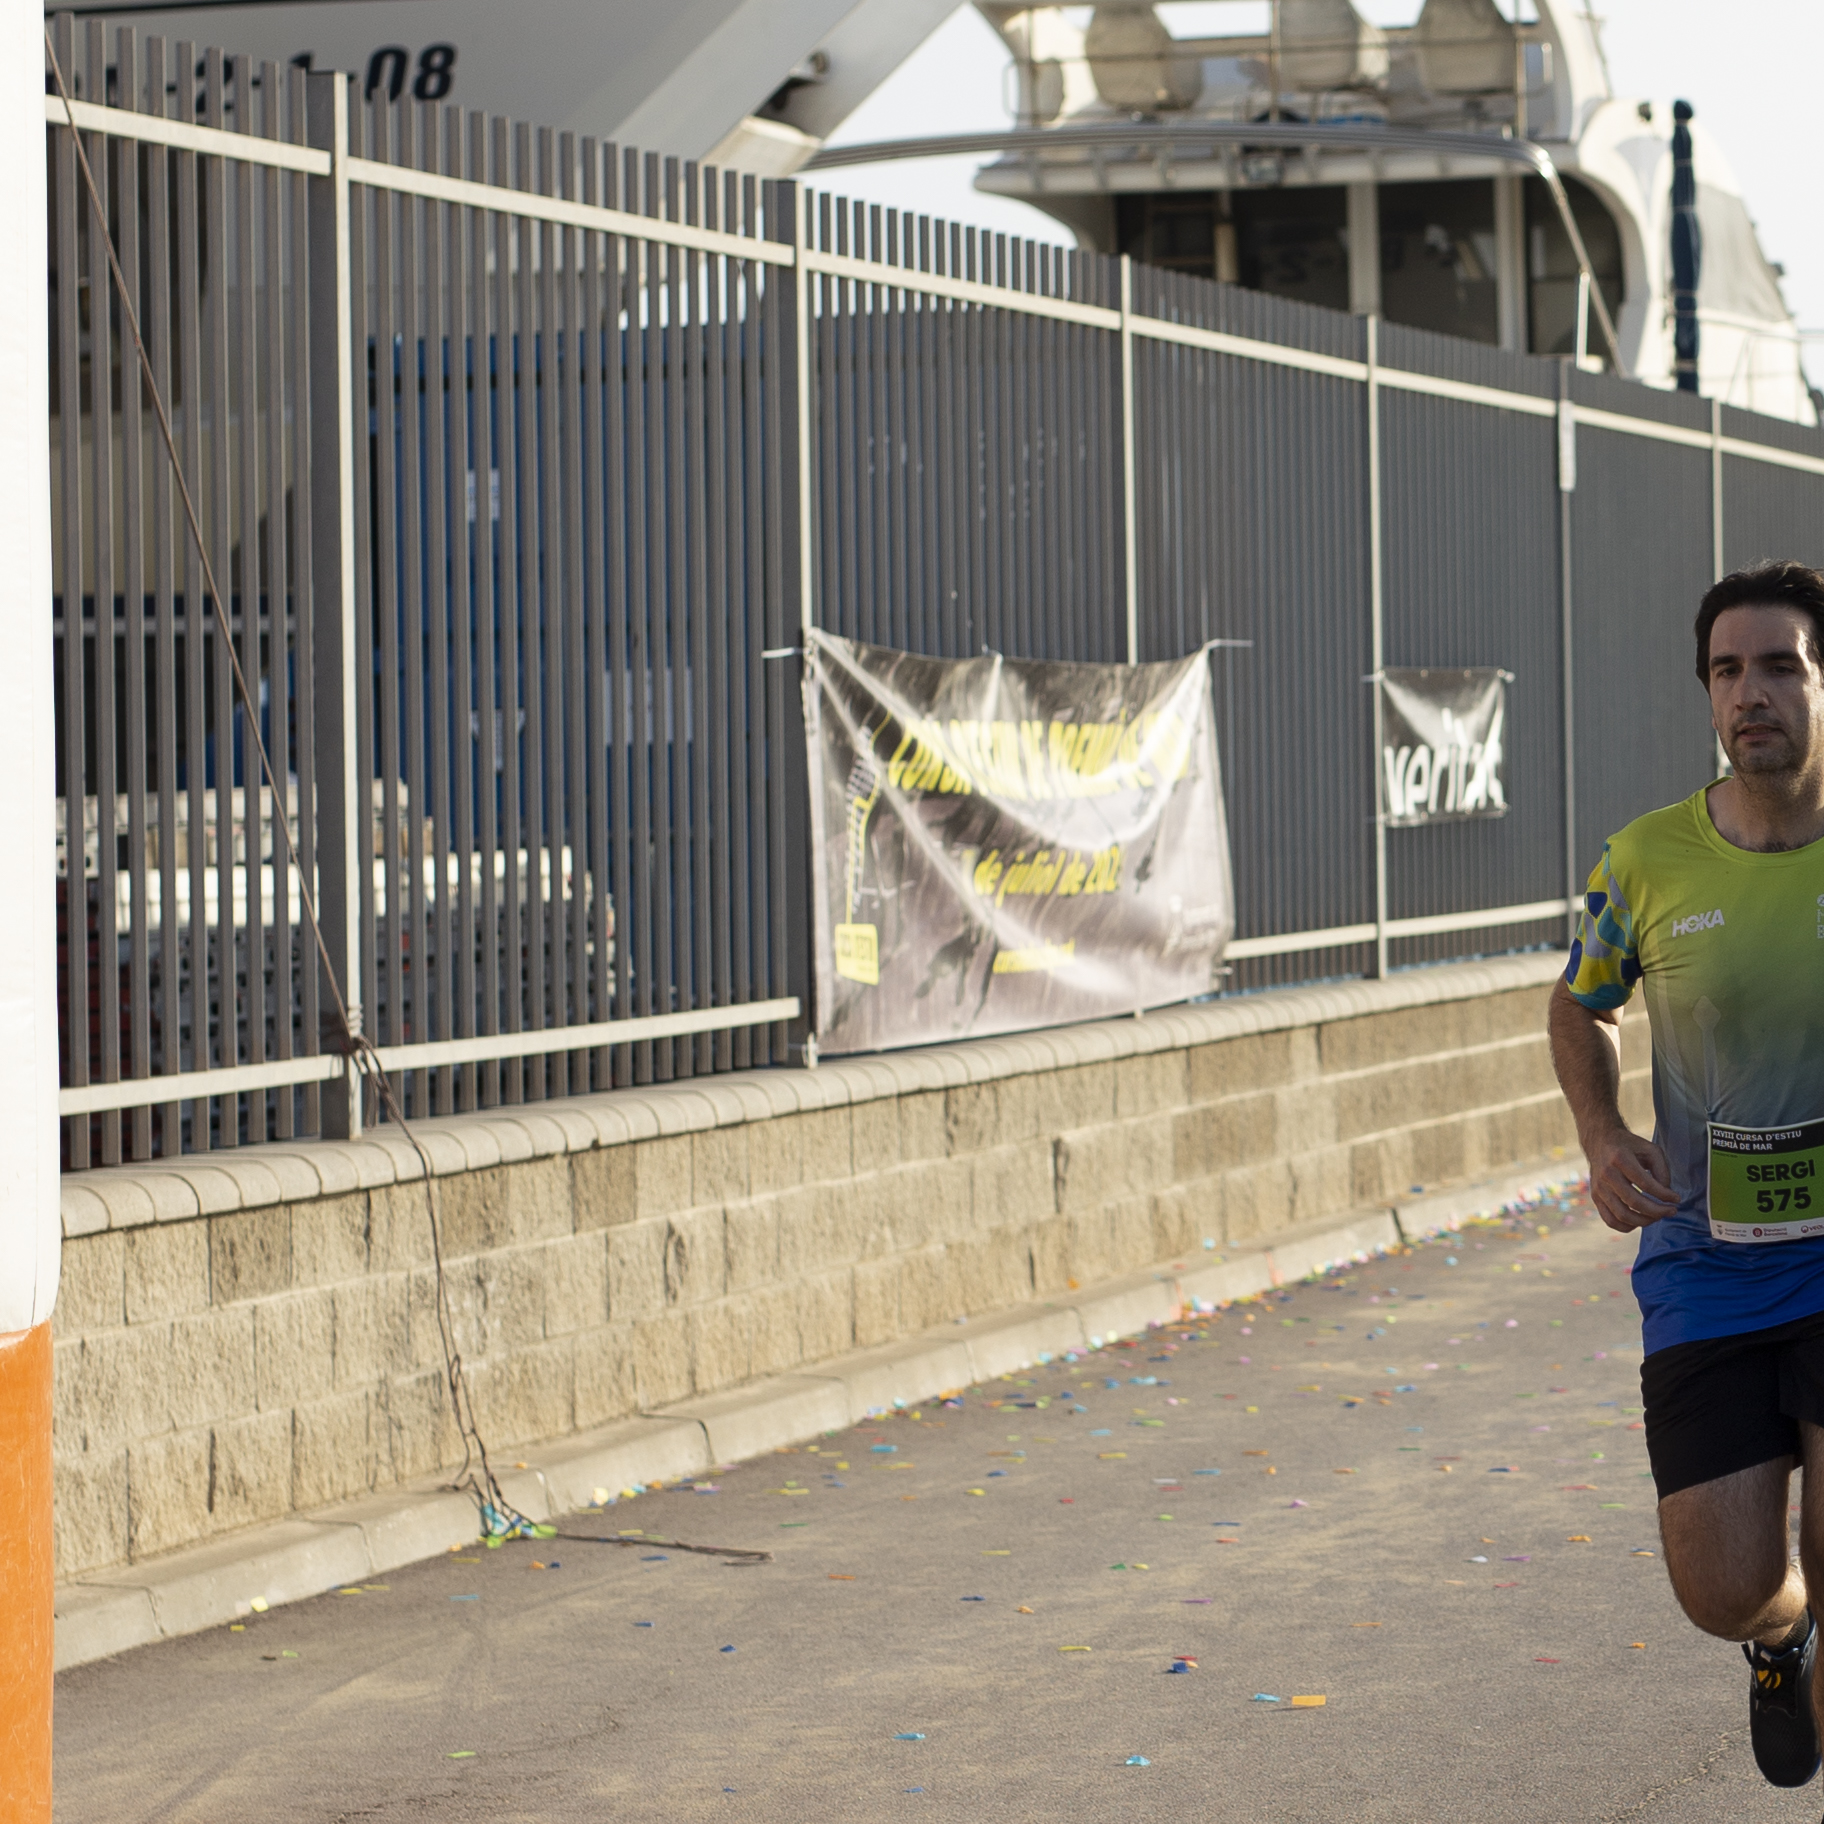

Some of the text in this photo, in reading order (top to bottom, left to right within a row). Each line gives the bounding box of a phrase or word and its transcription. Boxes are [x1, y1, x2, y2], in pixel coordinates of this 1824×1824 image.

[1671, 908, 1726, 938] HOKA
[1712, 1138, 1773, 1151] PREMIÀ DE MAR
[1735, 1132, 1763, 1142] CURSA
[1765, 1130, 1802, 1142] D'ESTIU
[1746, 1159, 1816, 1183] SERGI
[1756, 1186, 1812, 1213] 575
